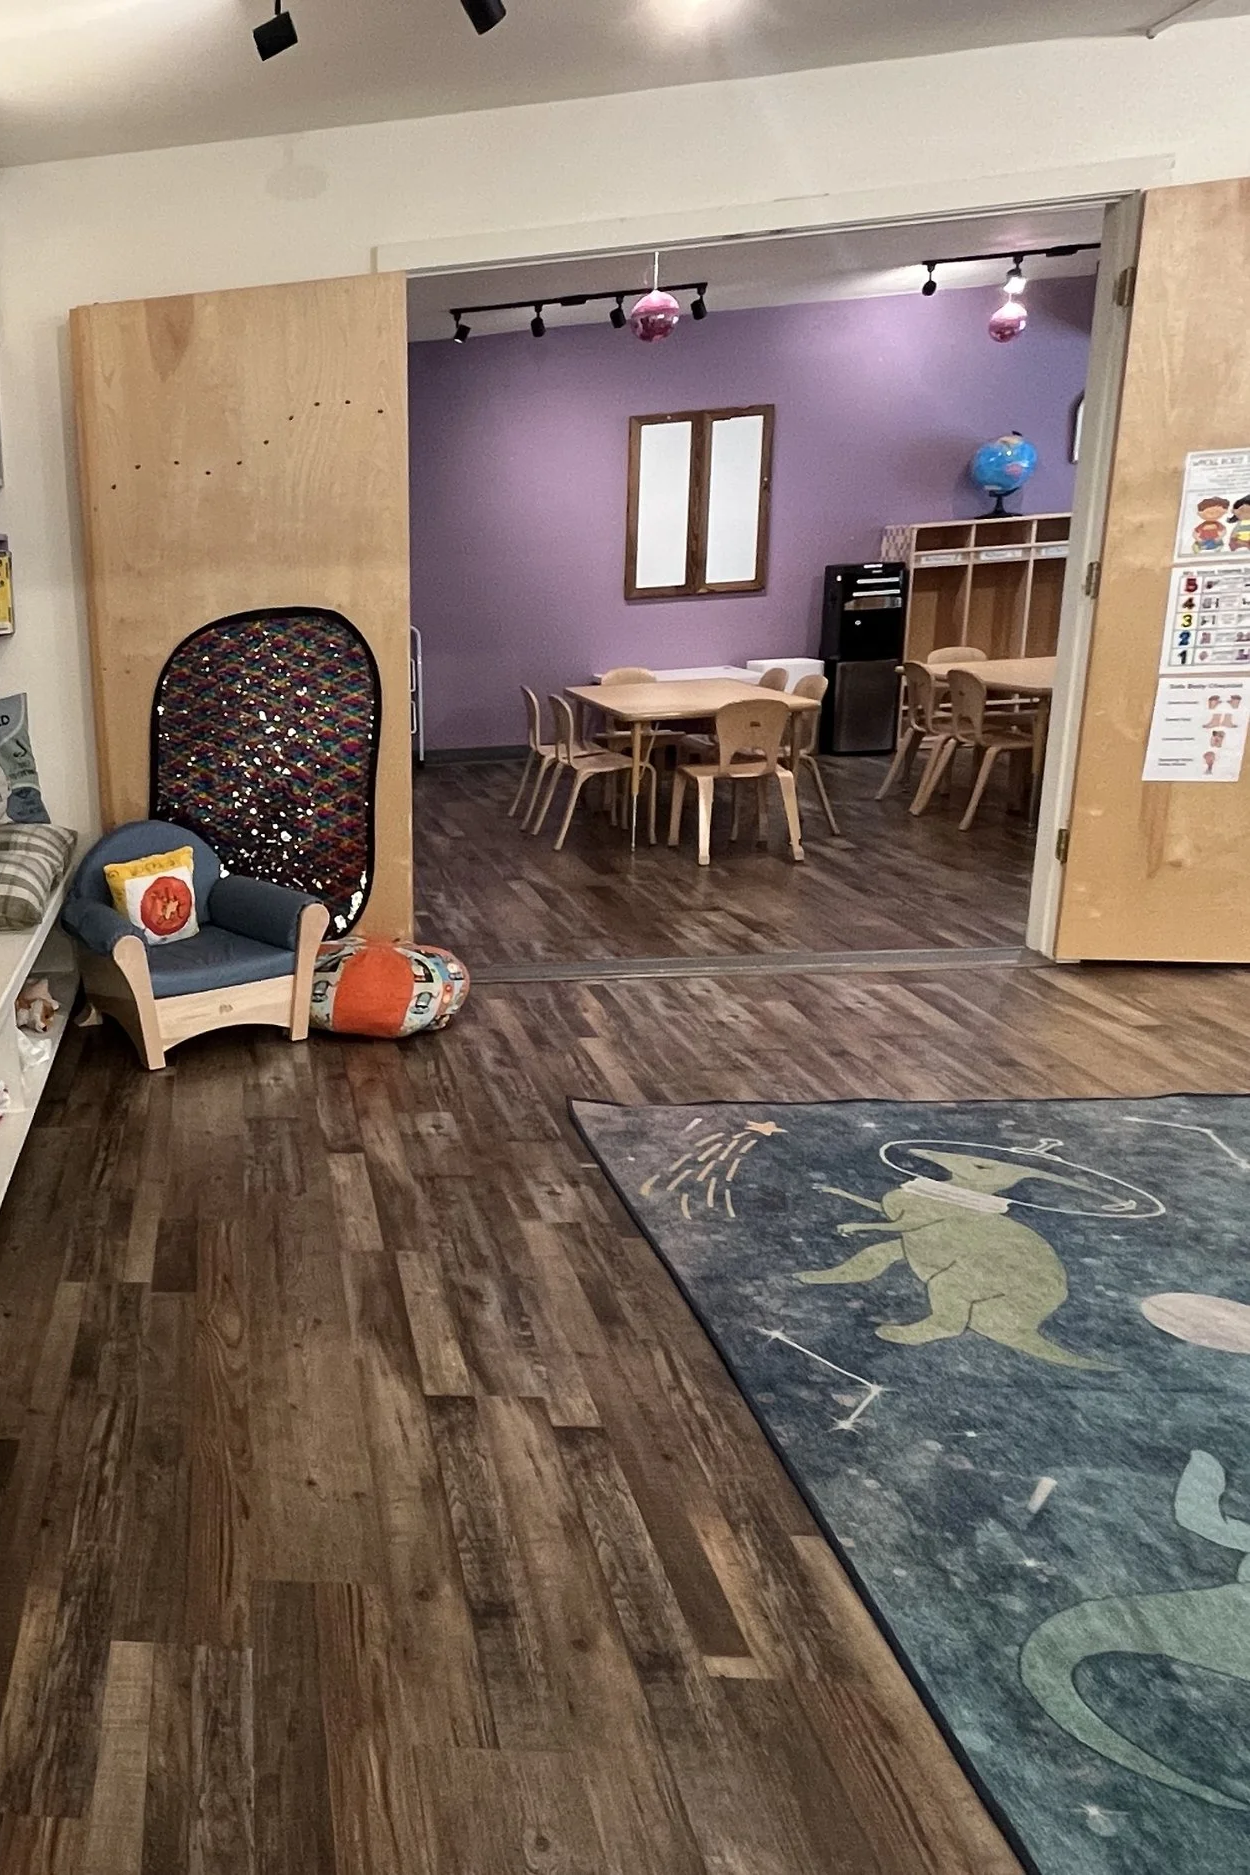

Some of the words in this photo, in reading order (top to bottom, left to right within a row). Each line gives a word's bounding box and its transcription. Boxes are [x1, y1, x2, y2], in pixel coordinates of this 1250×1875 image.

[1185, 578, 1198, 592] 5
[1182, 597, 1196, 610] 4
[1181, 614, 1192, 628] 3
[1178, 630, 1191, 646] 2
[1178, 650, 1187, 664] 1
